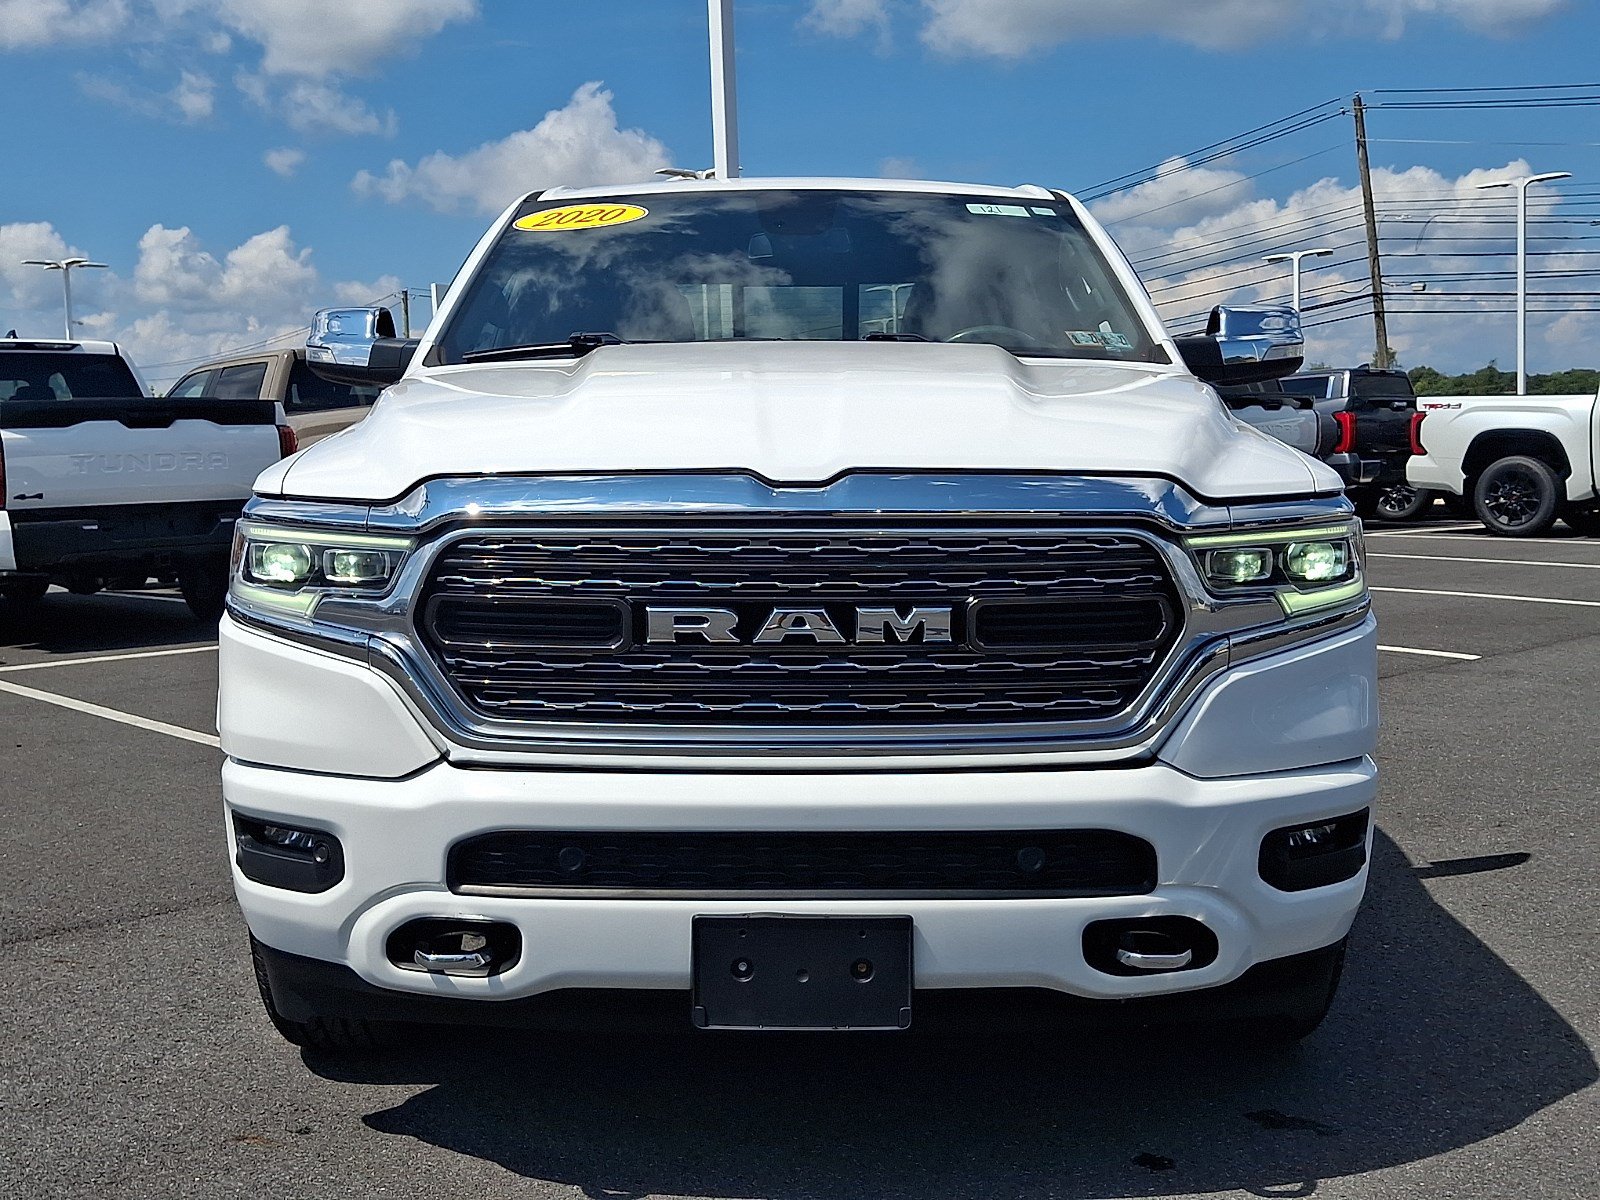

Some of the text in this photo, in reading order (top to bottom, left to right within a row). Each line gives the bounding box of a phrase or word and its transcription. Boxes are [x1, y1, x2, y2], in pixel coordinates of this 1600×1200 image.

[532, 208, 627, 227] 2020
[69, 452, 230, 474] TUNDRA
[645, 606, 953, 643] RAM
